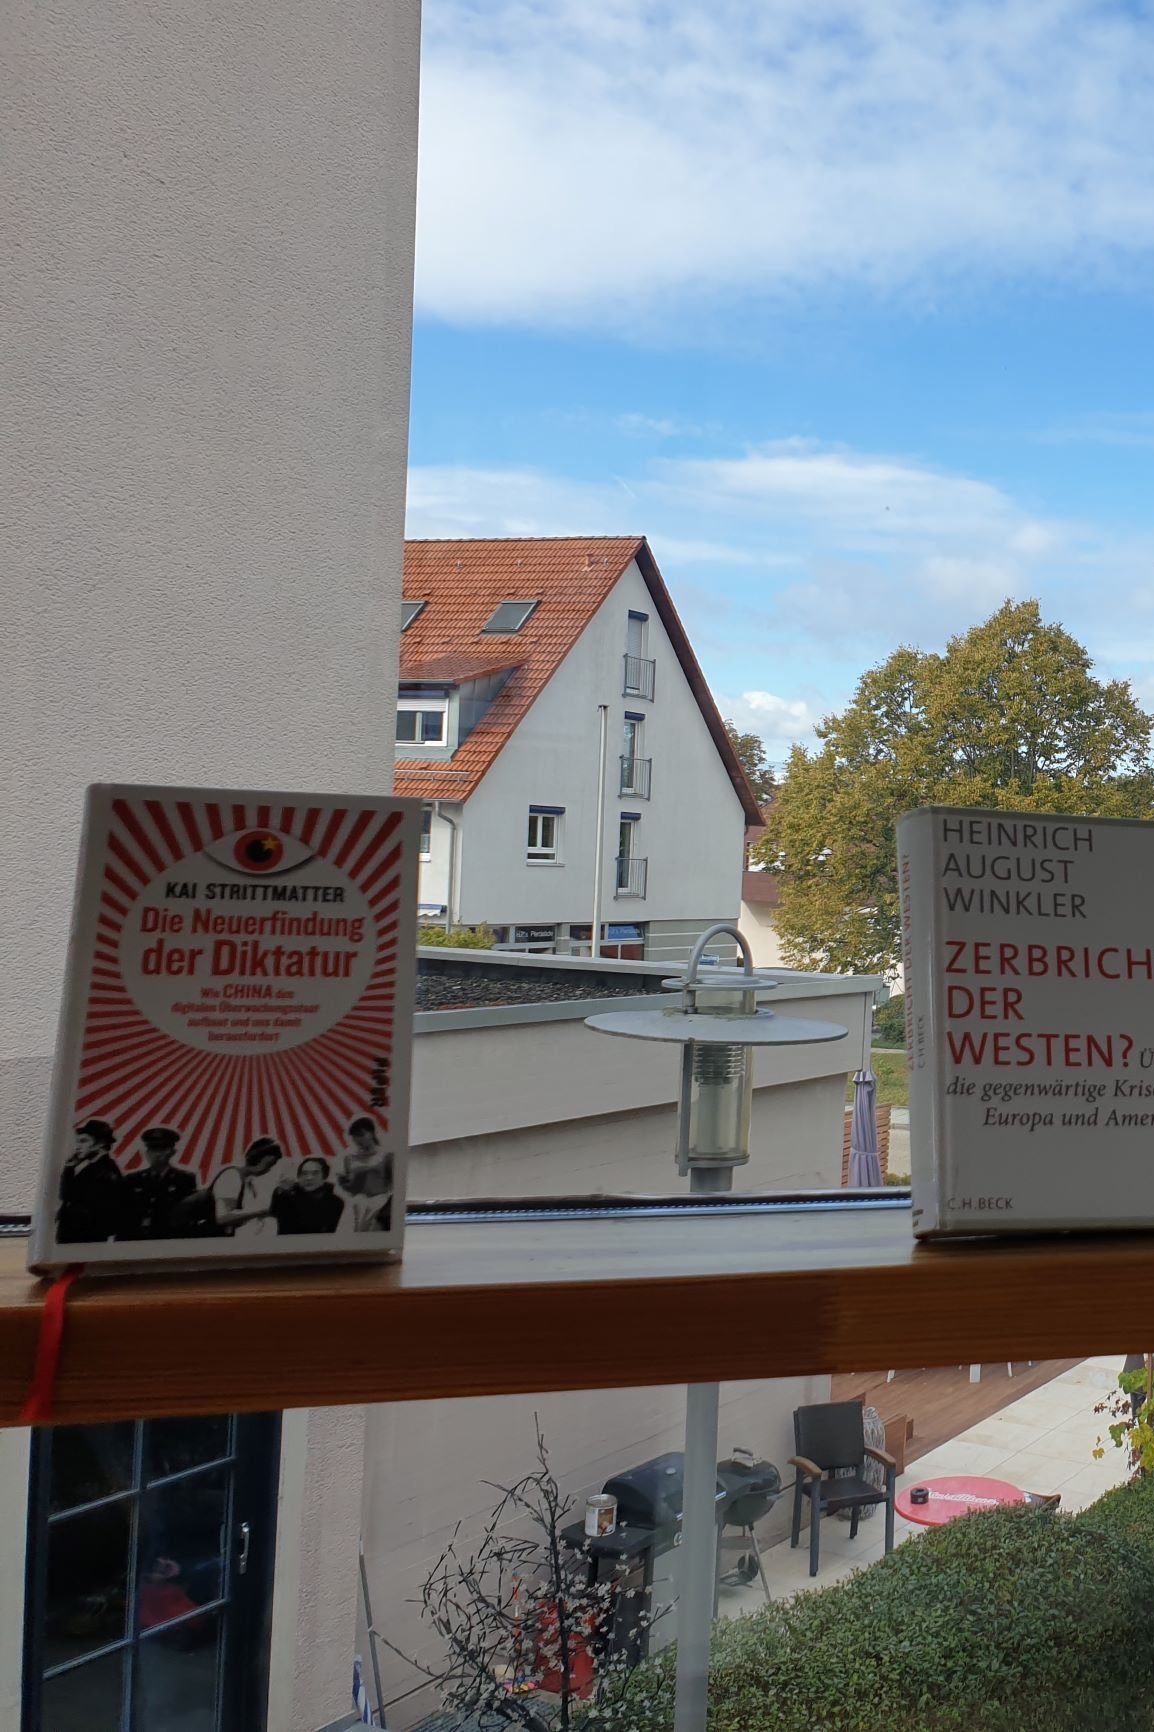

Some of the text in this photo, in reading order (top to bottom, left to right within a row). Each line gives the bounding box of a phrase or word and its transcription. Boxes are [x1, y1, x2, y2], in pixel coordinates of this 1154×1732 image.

[942, 818, 1094, 853] HEINRICH
[941, 853, 1075, 885] AUGUST
[165, 881, 345, 903] KAI STRITTMATTER
[943, 887, 1088, 919] WINKLER
[140, 906, 367, 943] Die Neuerfindung
[141, 938, 359, 979] der Diktatur
[222, 984, 273, 1000] CHINA
[946, 986, 1025, 1021] DER
[945, 1031, 1135, 1069] WESTEN?
[946, 1075, 977, 1097] die
[980, 1077, 1106, 1103] gegenwärtige
[983, 1108, 1054, 1132] Europa
[1061, 1109, 1099, 1128] und
[946, 1198, 1014, 1211] C.H.BECK
